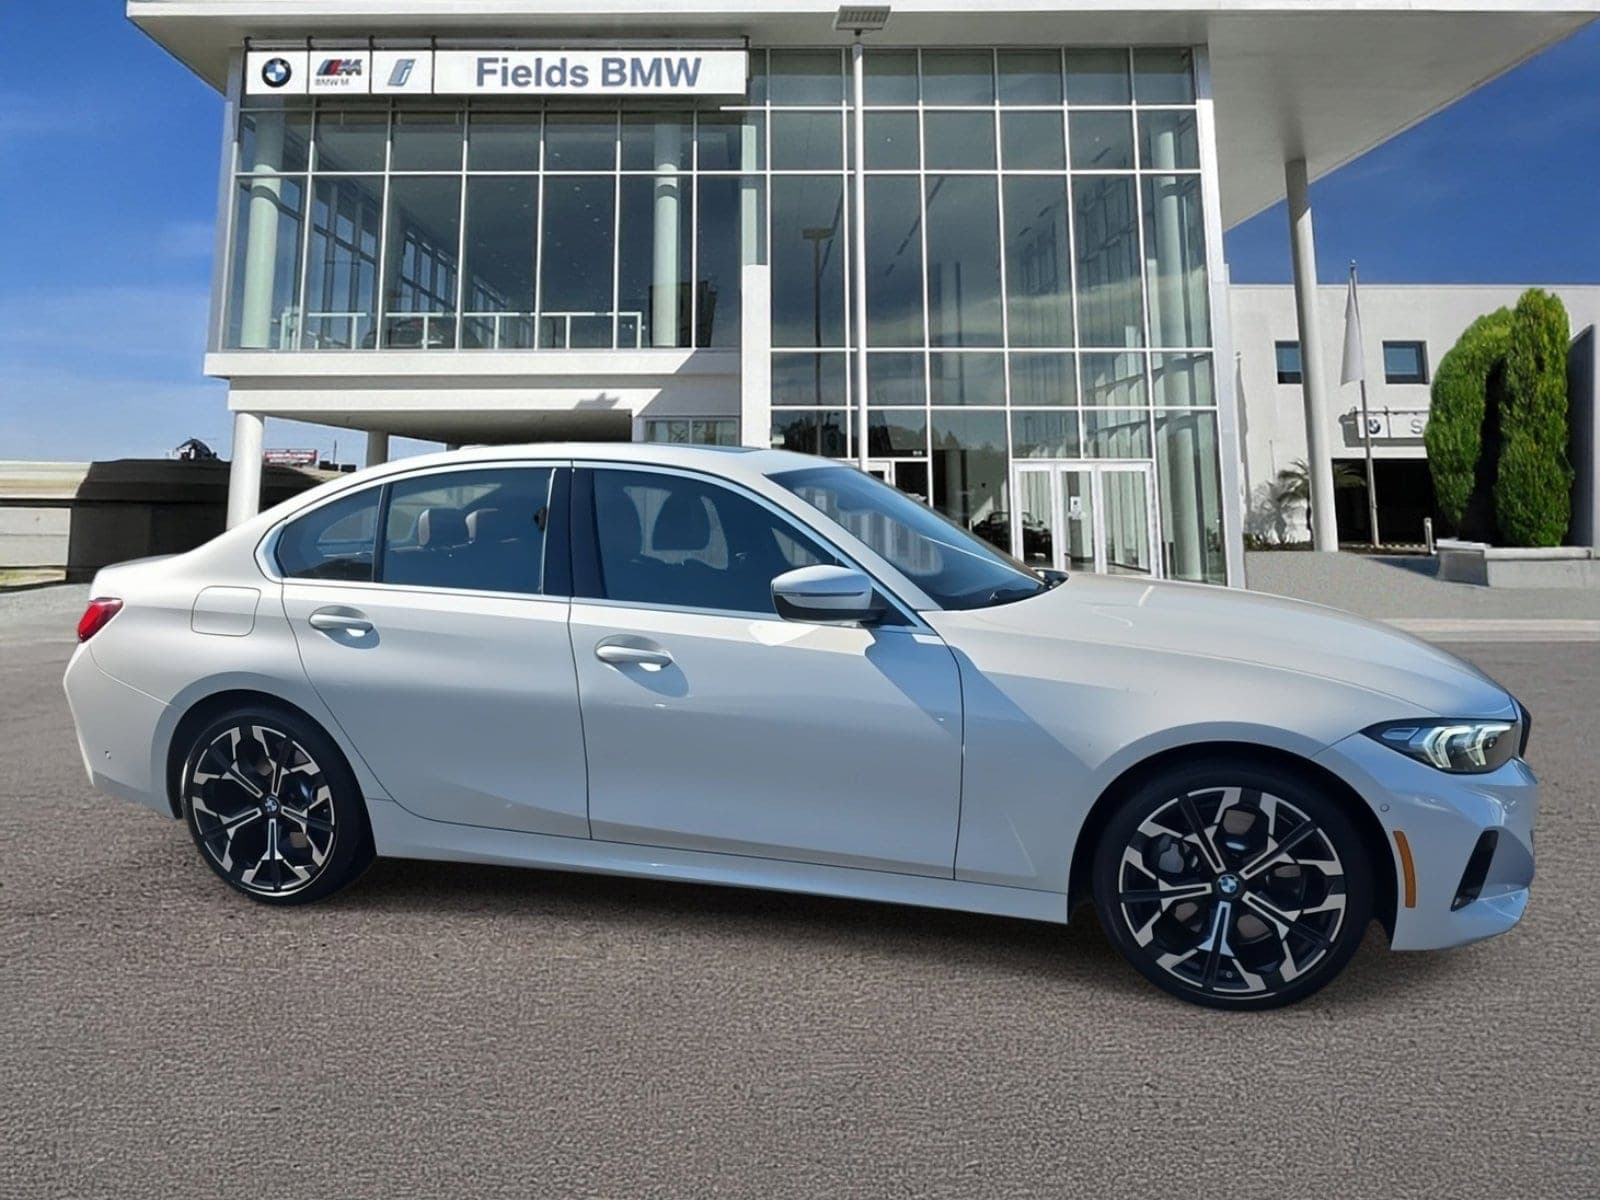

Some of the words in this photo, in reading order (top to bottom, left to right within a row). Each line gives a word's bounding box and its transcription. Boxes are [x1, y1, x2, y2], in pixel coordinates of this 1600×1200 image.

[476, 57, 589, 87] Fields
[601, 57, 702, 87] BMW
[315, 78, 338, 86] BMW
